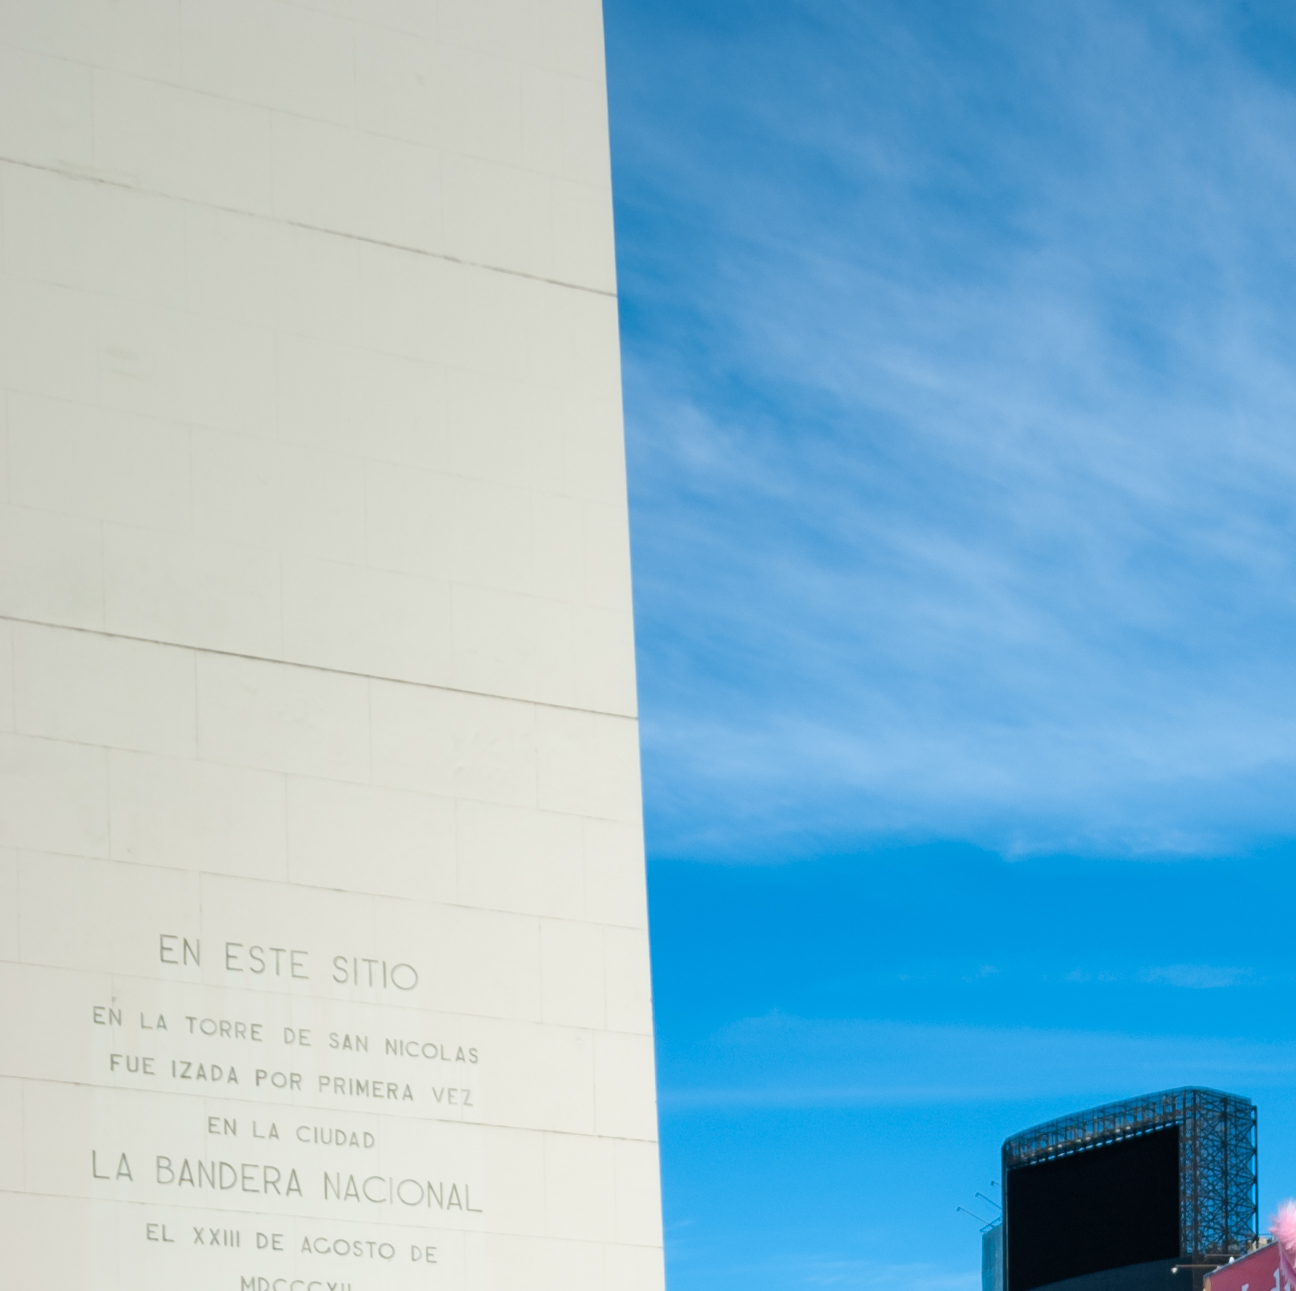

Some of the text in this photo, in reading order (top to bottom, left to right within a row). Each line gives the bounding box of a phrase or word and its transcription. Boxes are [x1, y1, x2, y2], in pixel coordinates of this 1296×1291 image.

[158, 933, 419, 990] EN ESTE SITIO
[92, 1005, 480, 1064] EN LA TORRE DE SAN NICOLAS
[109, 1054, 474, 1107] FUE IZADA POR PRIMERA VEZ
[208, 1116, 375, 1148] EN LA CIUDAD
[91, 1150, 483, 1212] LA BANDERA NACIONAL
[146, 1223, 438, 1264] EL XXIII DE AGOSTO DE
